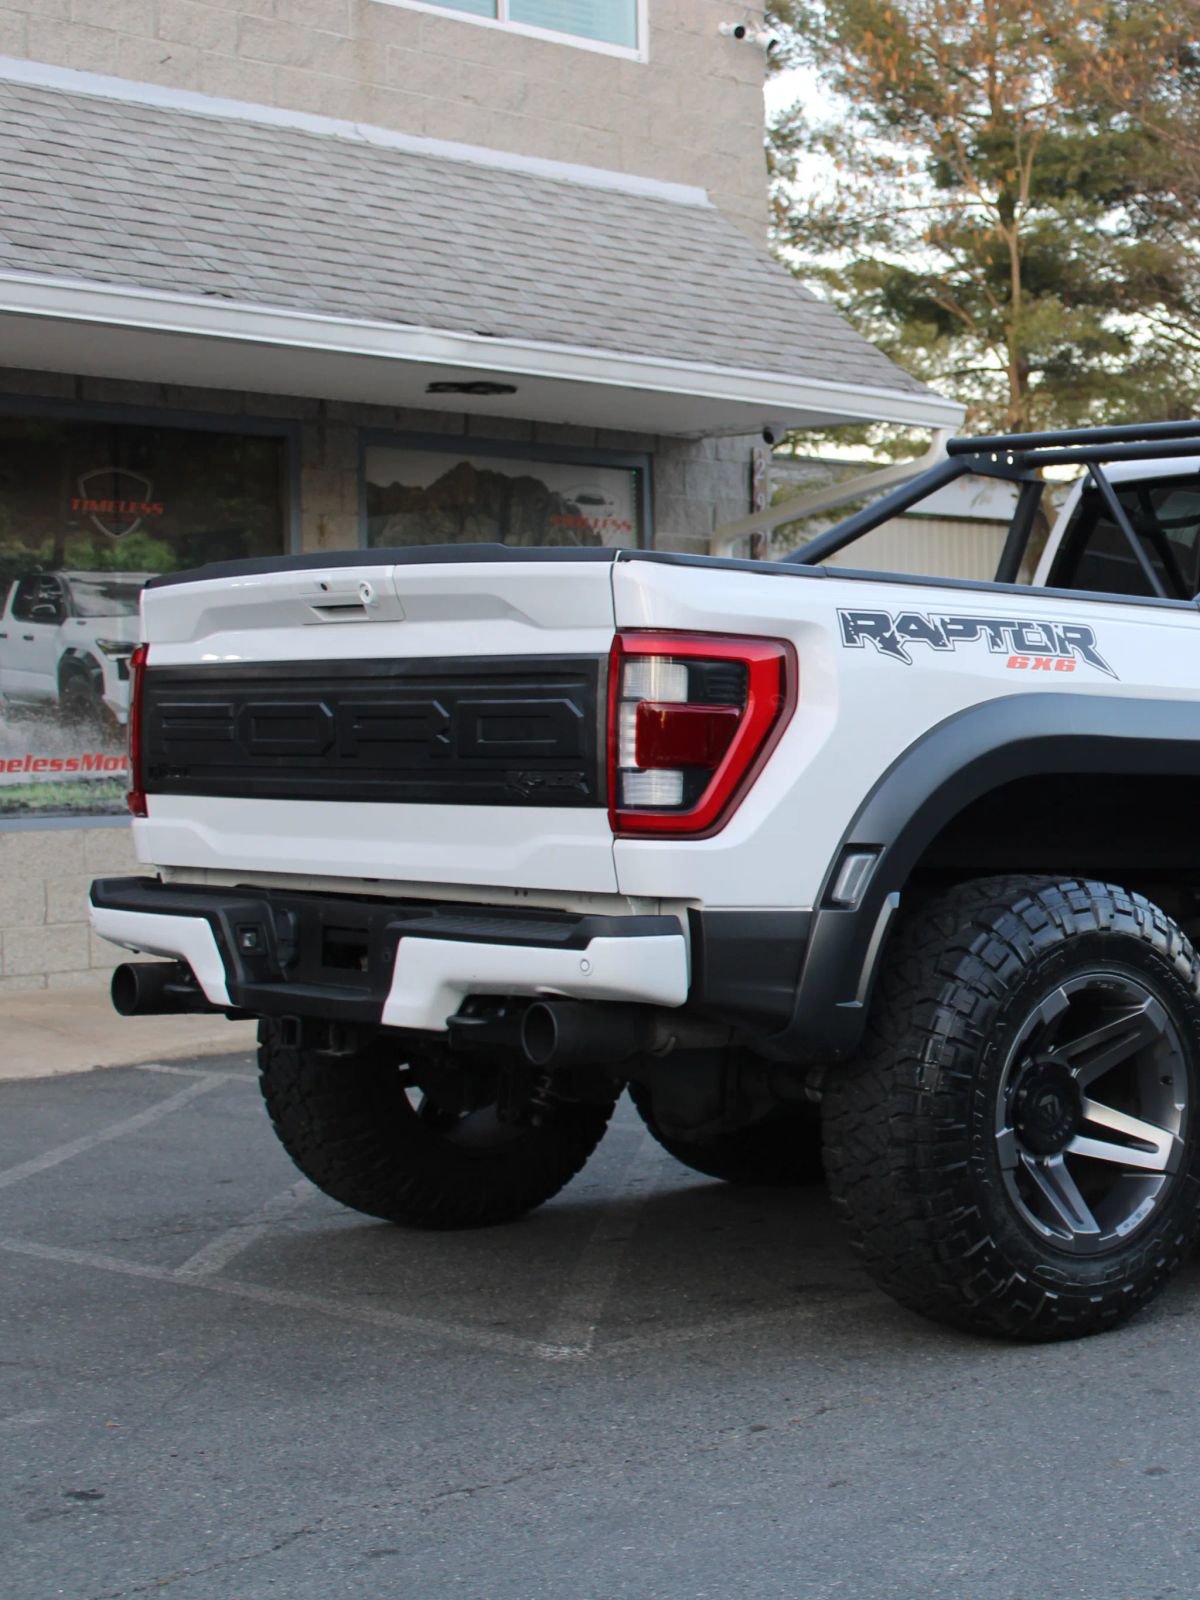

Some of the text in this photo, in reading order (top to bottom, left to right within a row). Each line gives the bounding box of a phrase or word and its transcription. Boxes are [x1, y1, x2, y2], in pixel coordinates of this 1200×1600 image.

[71, 496, 164, 514] TIMELESS
[836, 608, 1120, 681] RAPTOR
[153, 698, 585, 759] FORD
[0, 752, 129, 773] elessMot
